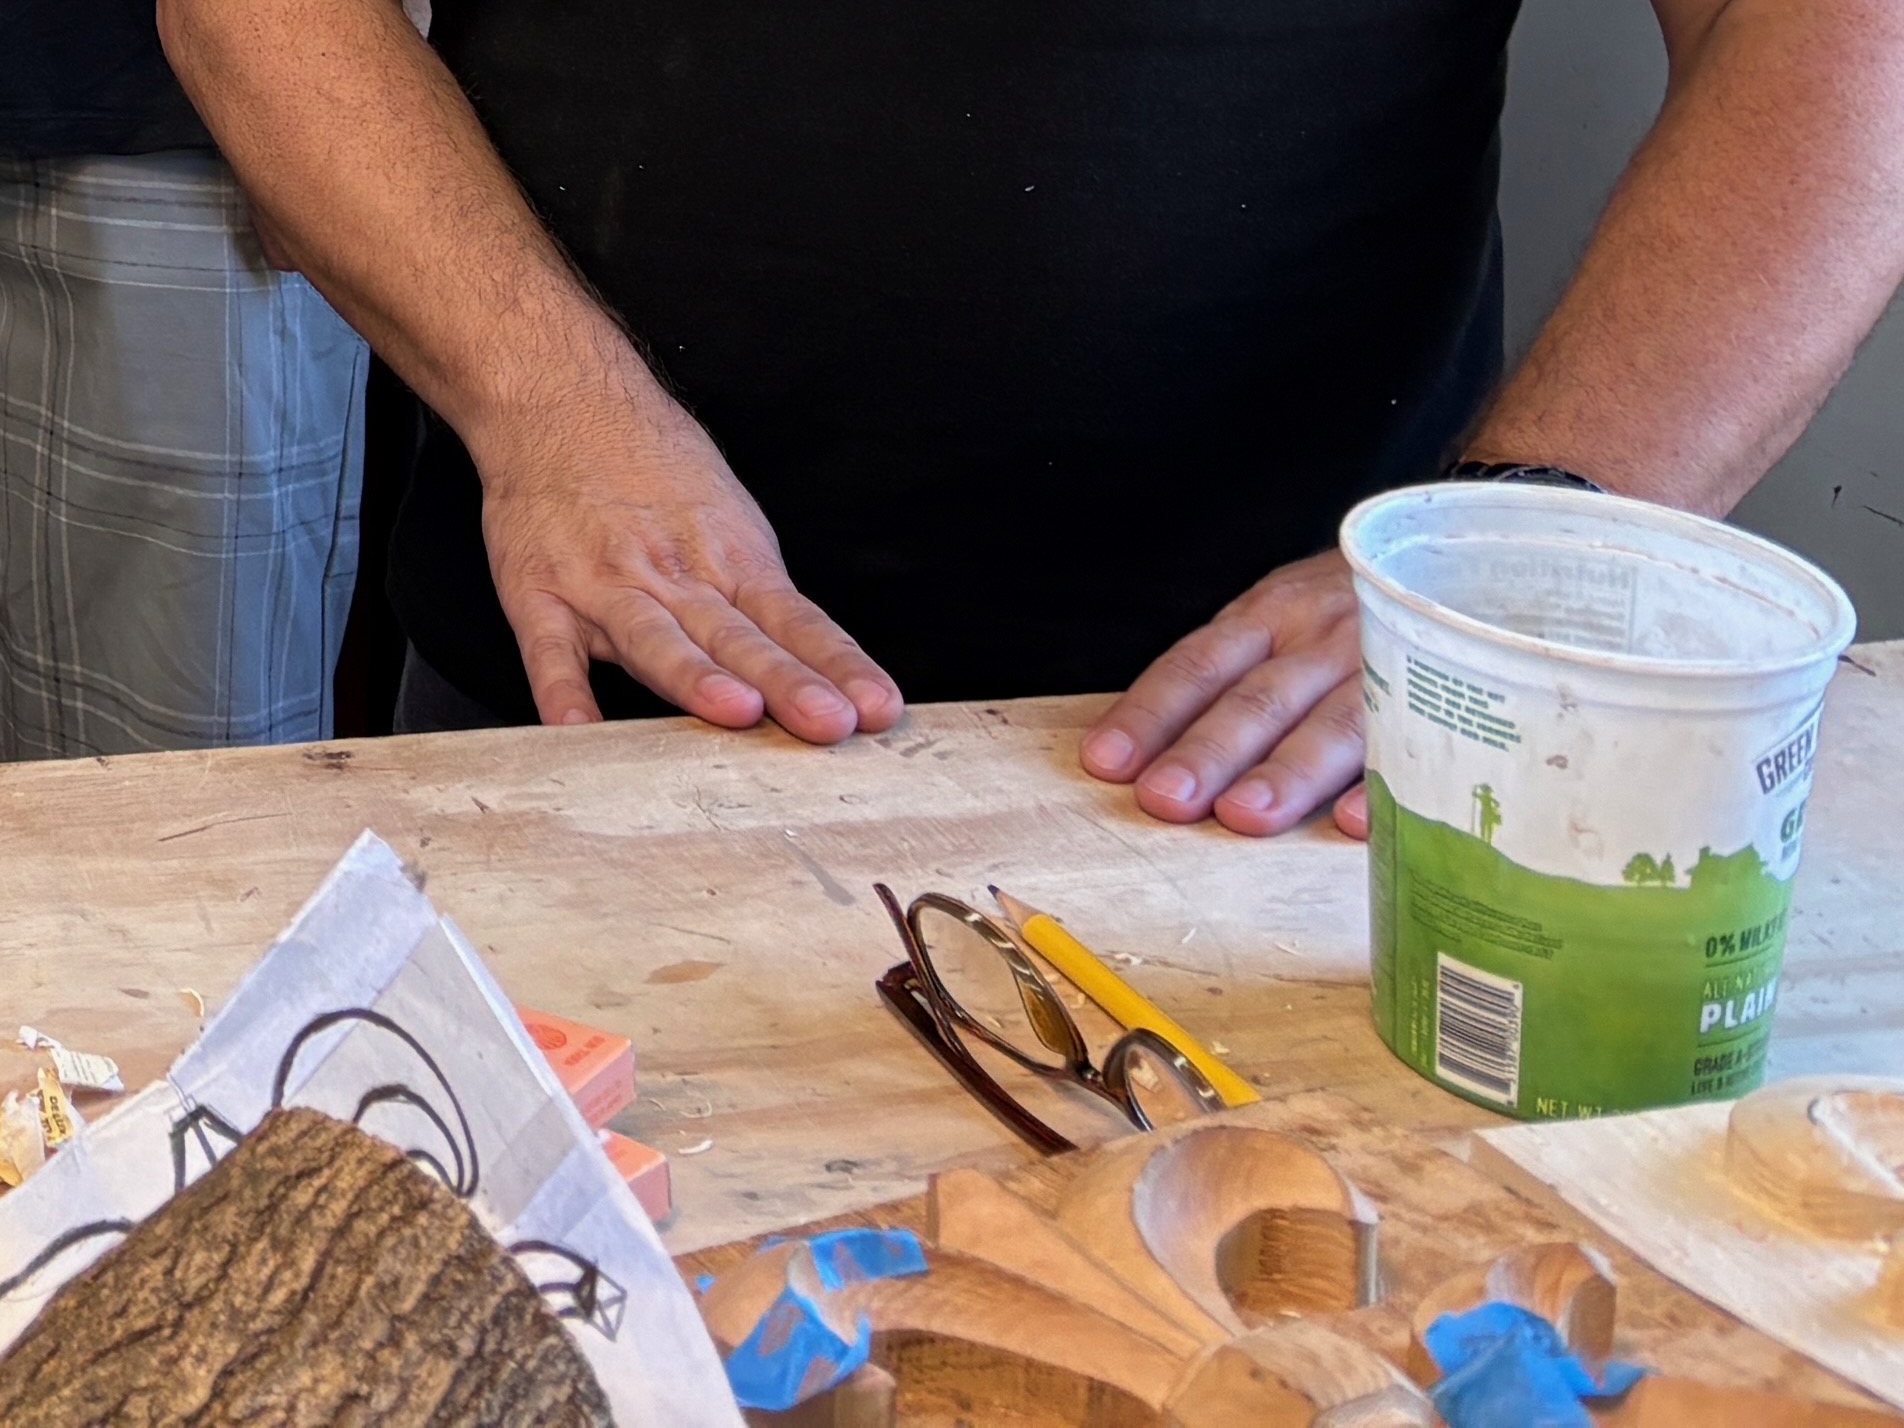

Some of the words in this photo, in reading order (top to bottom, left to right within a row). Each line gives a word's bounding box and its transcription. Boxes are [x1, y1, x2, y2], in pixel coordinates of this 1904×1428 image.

[1756, 724, 1815, 795] GREEN
[1705, 935, 1735, 958] 0%
[1705, 981, 1728, 998] ALL
[1700, 980, 1775, 1033] PLAIN
[1694, 1052, 1732, 1075] GRADE
[1537, 1098, 1568, 1117] NET
